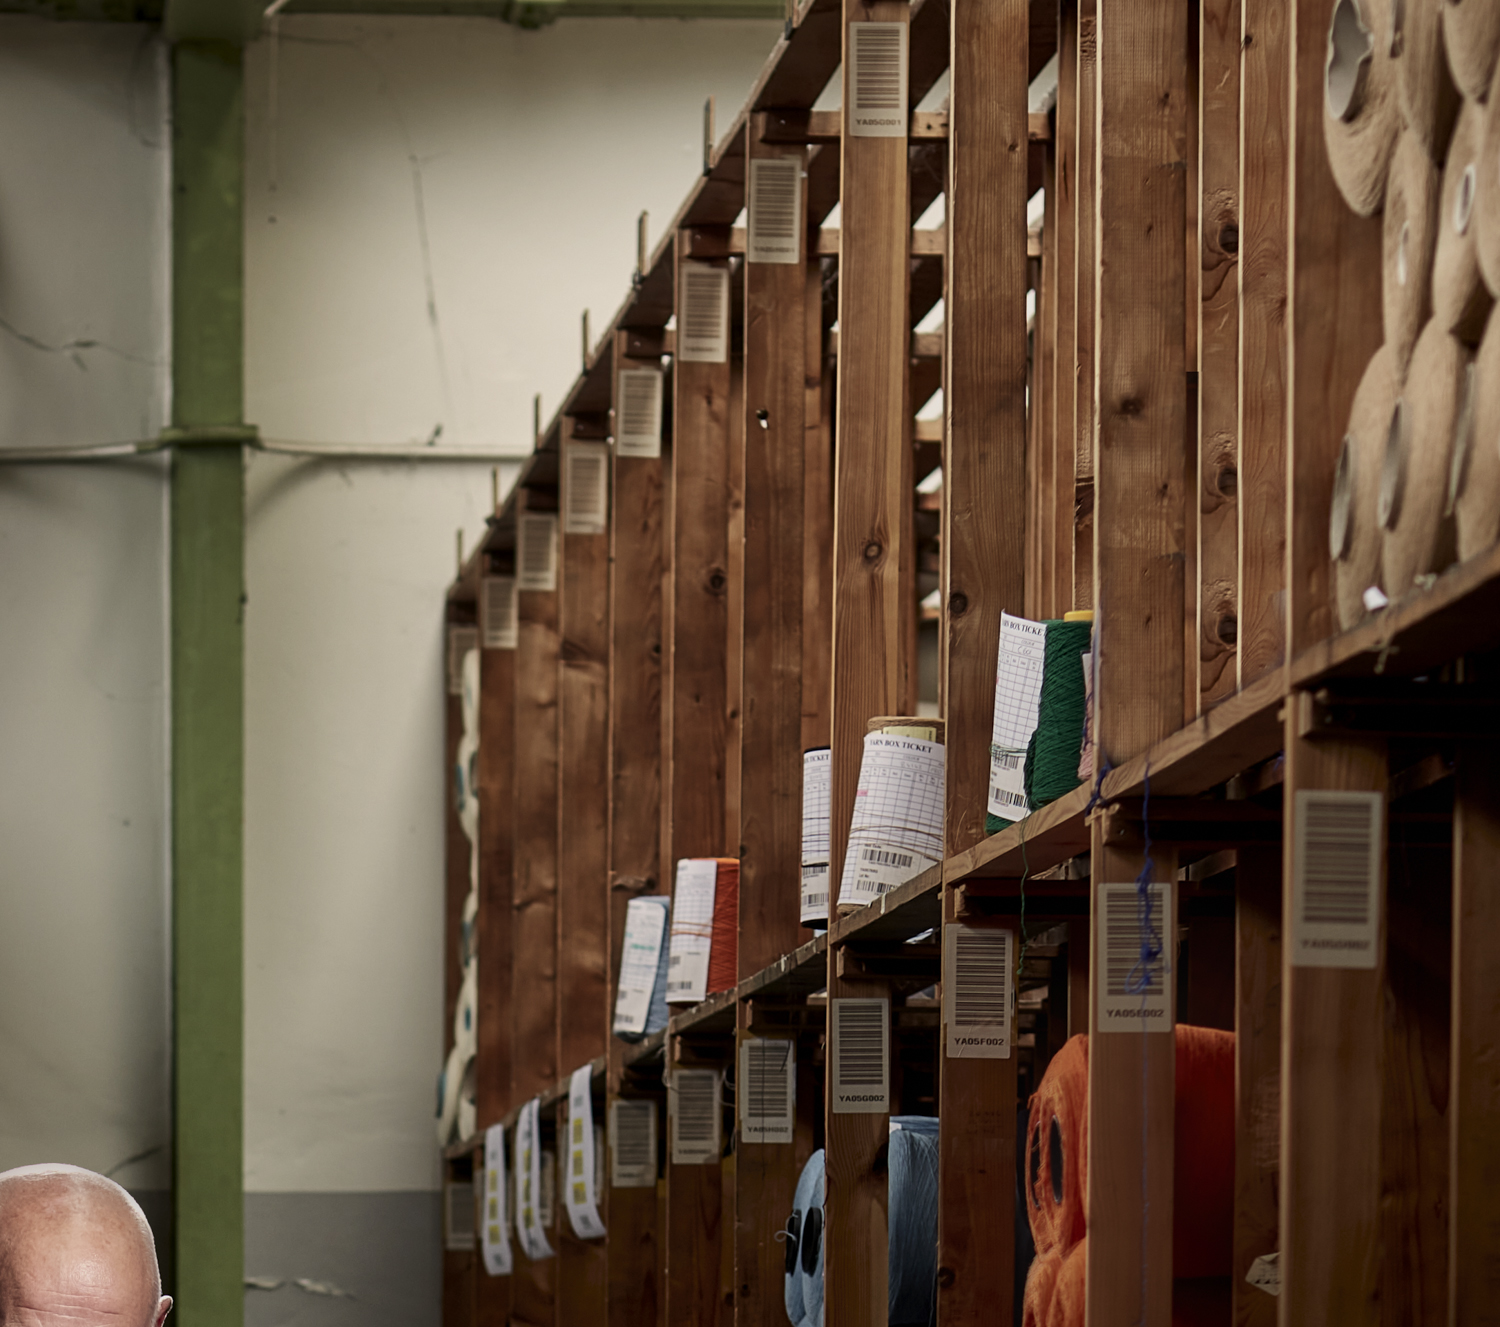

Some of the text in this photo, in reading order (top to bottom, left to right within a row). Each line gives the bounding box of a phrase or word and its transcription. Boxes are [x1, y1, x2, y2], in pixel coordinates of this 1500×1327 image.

[1010, 621, 1021, 631] BOX
[1021, 624, 1046, 637] TICKE
[885, 740, 900, 749] BOX
[902, 742, 934, 754] TICKET
[1106, 1009, 1164, 1018] YA05E002
